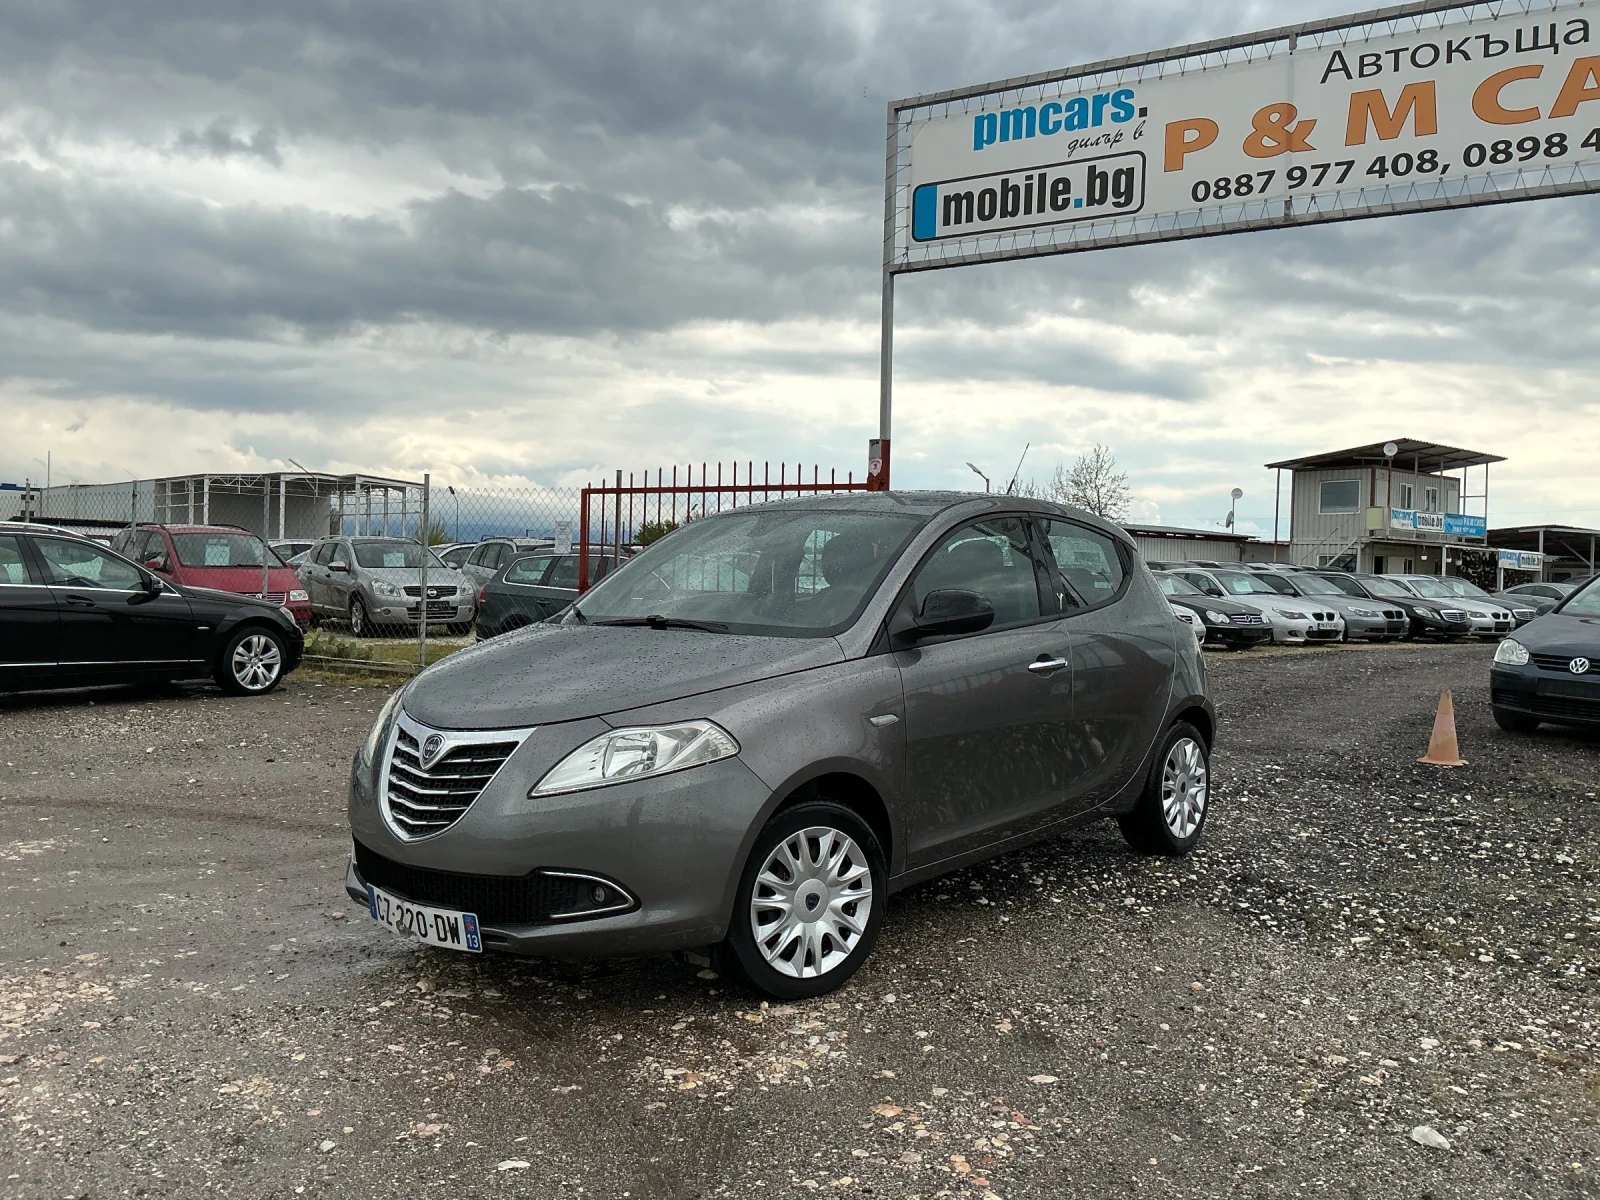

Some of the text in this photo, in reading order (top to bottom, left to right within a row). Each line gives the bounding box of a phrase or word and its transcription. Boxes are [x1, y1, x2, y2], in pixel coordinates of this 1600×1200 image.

[1320, 18, 1590, 85] Автокъща
[1068, 129, 1124, 157] дилър
[1164, 117, 1219, 173] P
[1243, 102, 1317, 158] &
[1345, 80, 1437, 146] M
[943, 165, 1135, 226] mobile.bg
[1191, 169, 1276, 202] 0887
[1286, 159, 1356, 189] 977
[1366, 149, 1451, 179] 408,
[1463, 132, 1569, 168] 0898
[467, 933, 479, 948] 13
